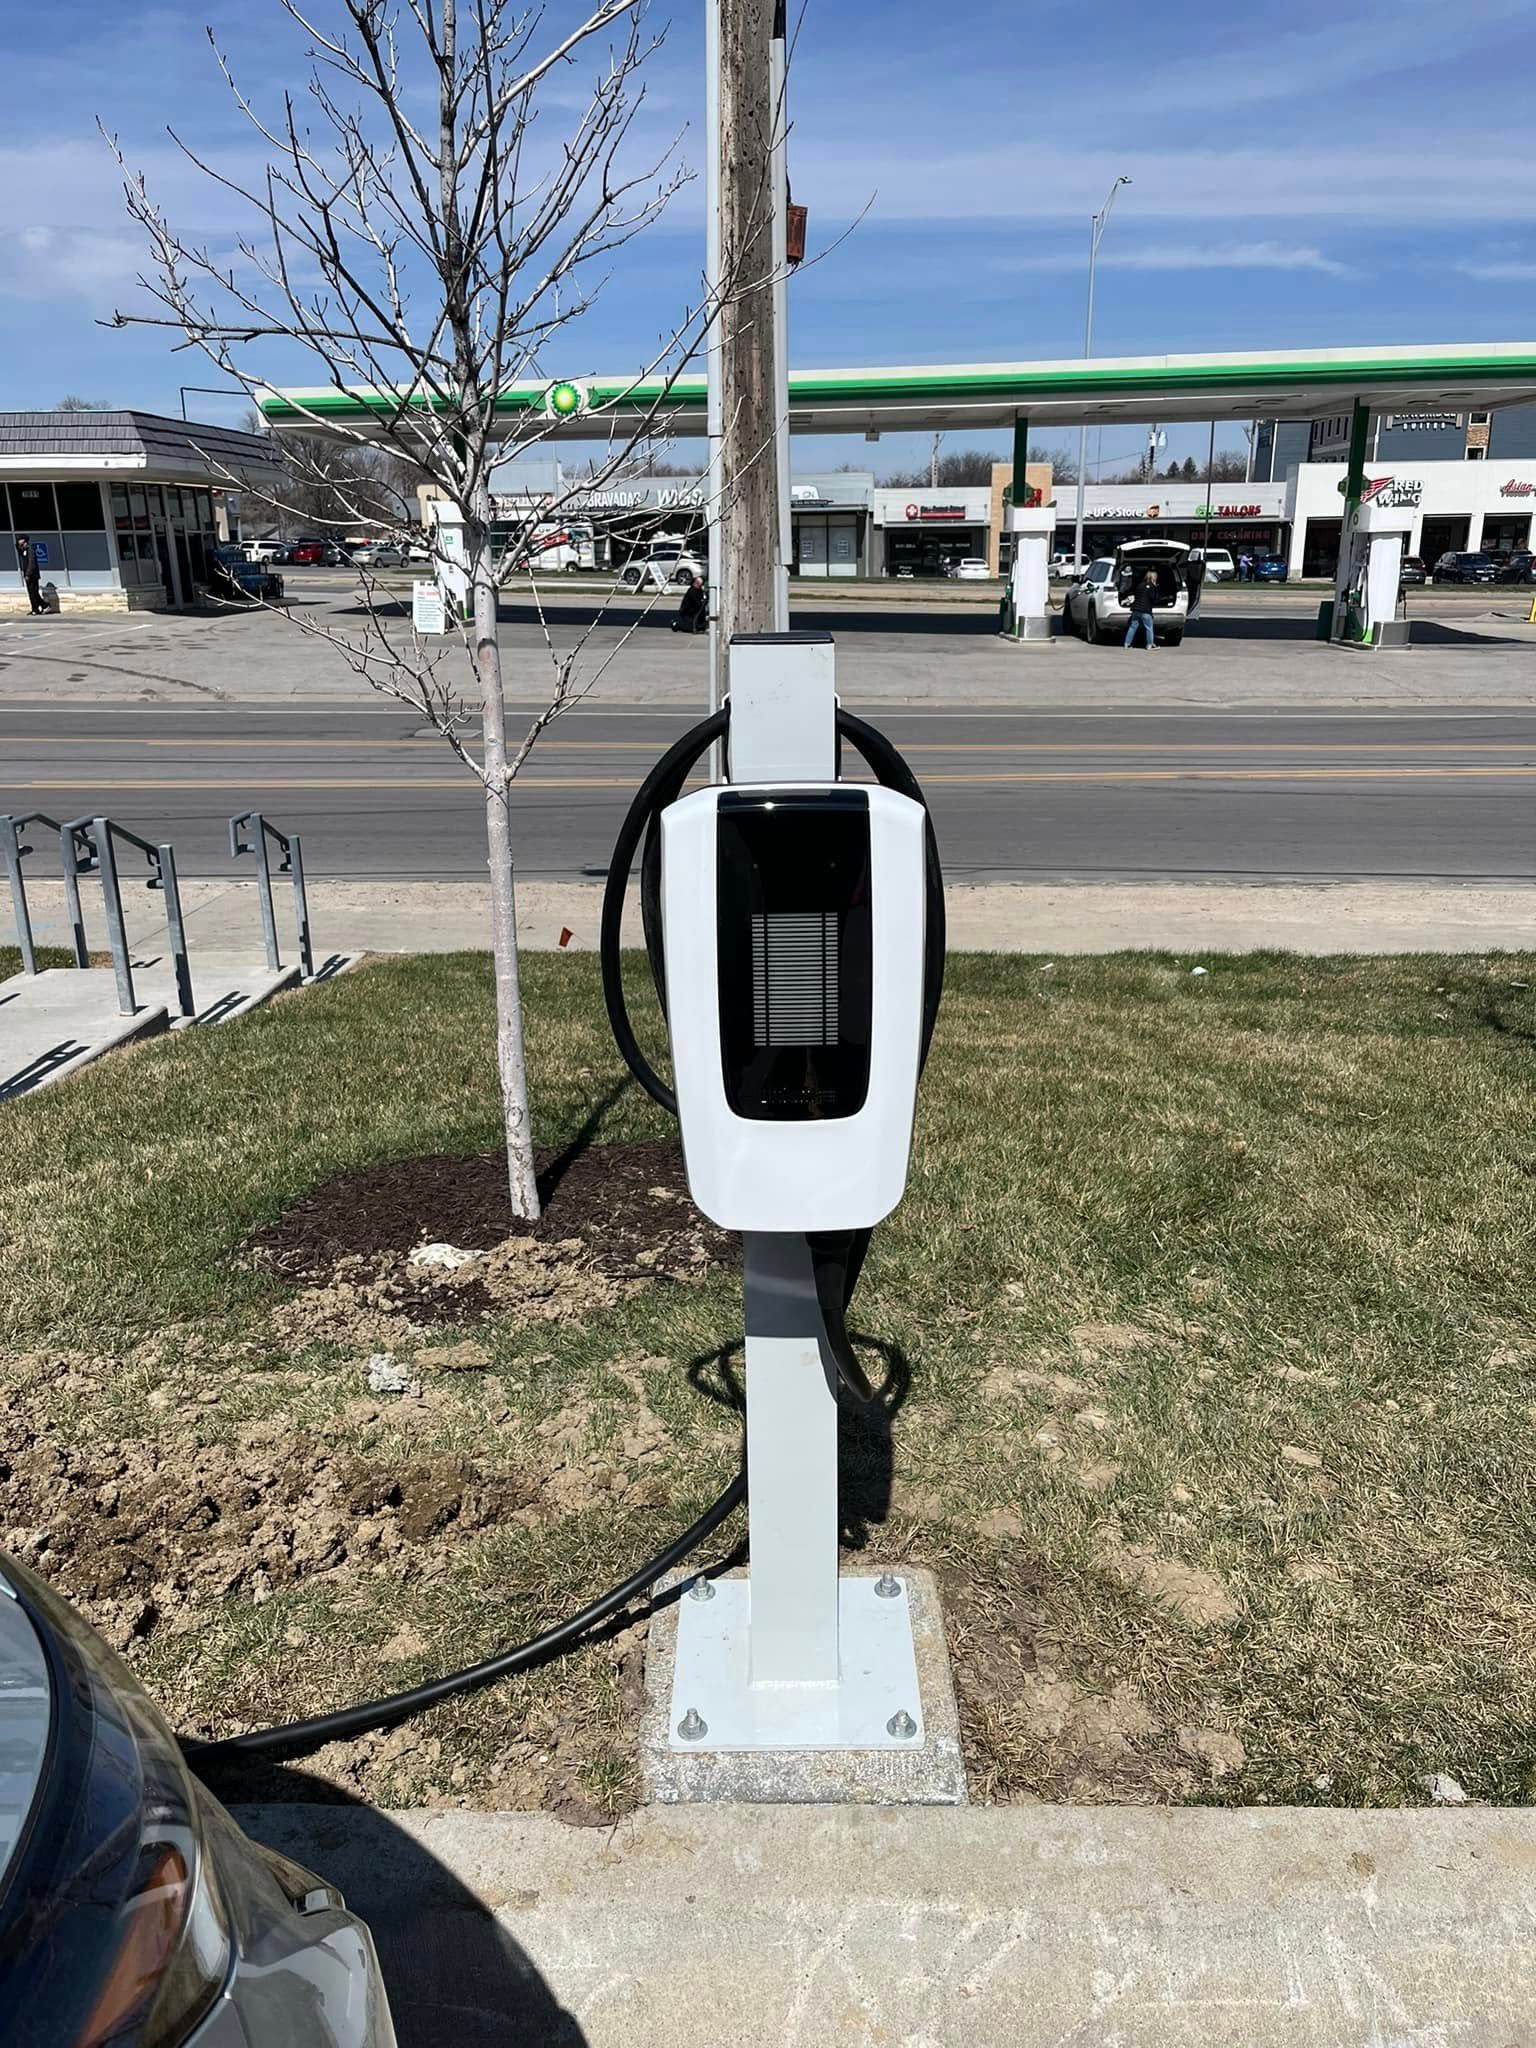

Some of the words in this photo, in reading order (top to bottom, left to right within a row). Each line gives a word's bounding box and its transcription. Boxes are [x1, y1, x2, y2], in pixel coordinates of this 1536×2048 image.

[1403, 422, 1446, 431] SUITES
[1393, 480, 1424, 492] RED
[1376, 492, 1422, 507] WING
[1093, 505, 1115, 518] UPS
[1116, 506, 1144, 518] Store
[1218, 505, 1262, 516] TAILORS
